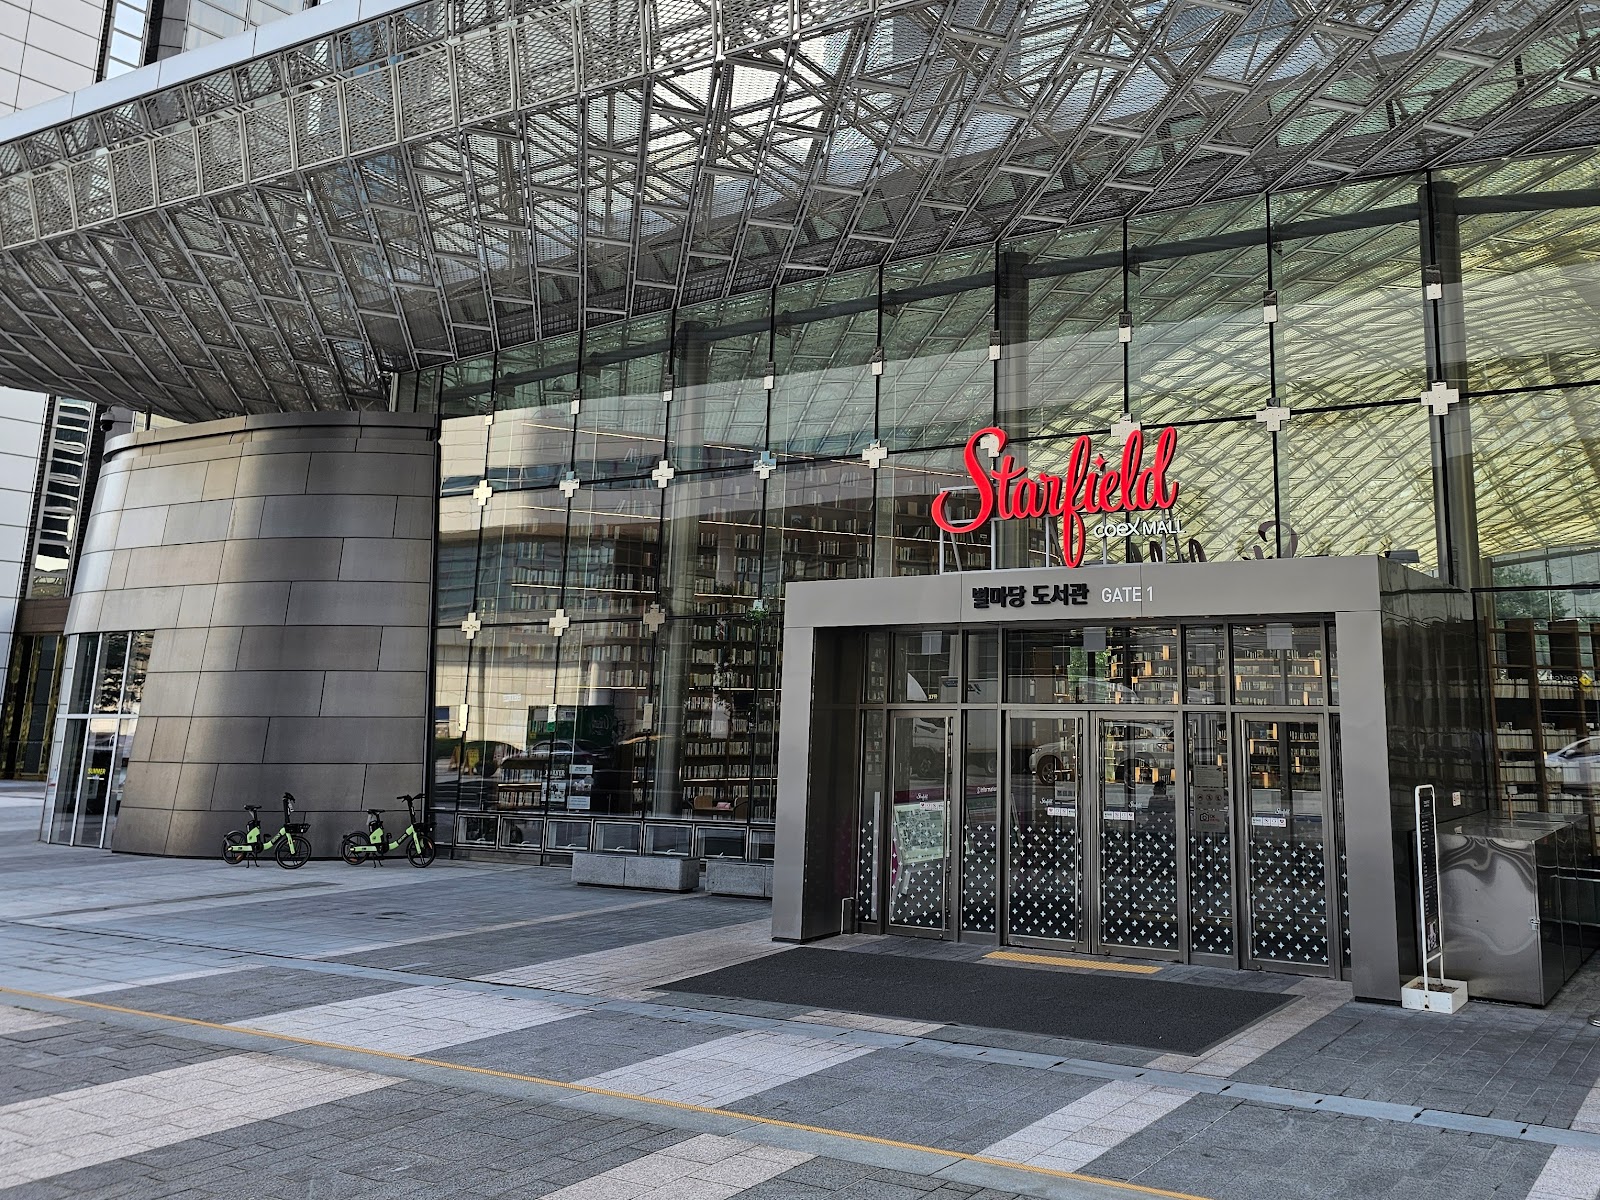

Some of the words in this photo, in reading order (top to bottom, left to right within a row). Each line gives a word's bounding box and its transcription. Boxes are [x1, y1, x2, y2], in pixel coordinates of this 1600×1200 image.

[931, 426, 1179, 569] Starfield
[1142, 519, 1186, 535] MALL
[972, 585, 1027, 609] 별마당
[1031, 583, 1090, 606] 도서관
[1101, 586, 1142, 603] GATE
[1146, 586, 1153, 602] 1
